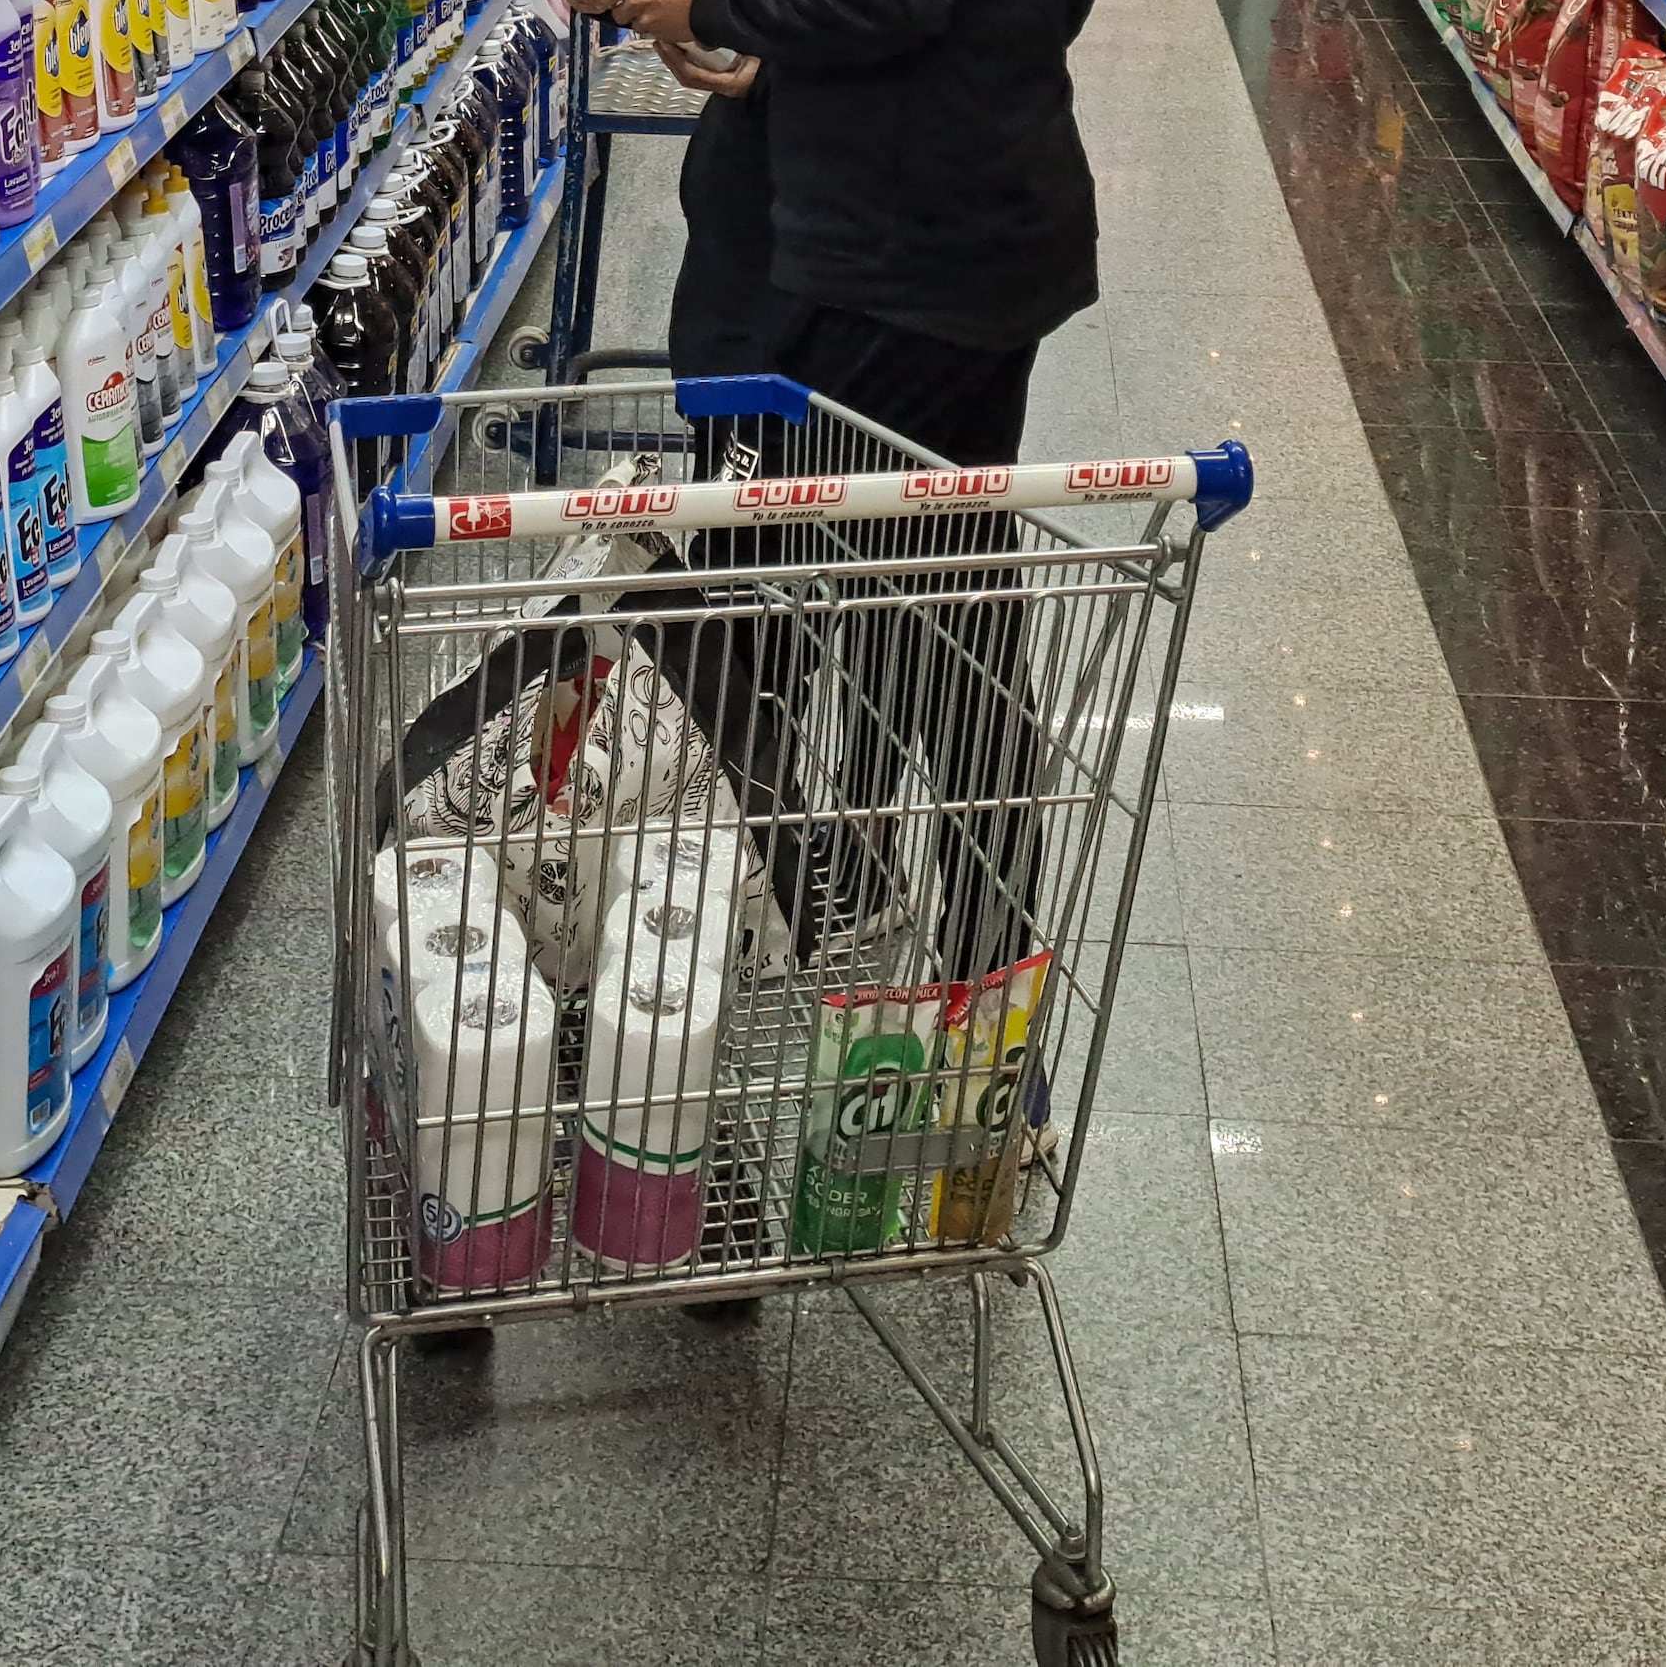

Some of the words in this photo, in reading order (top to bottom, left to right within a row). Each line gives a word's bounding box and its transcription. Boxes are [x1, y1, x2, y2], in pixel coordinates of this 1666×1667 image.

[901, 467, 1012, 501] COTO
[1065, 459, 1174, 492] COTO
[563, 487, 679, 520] COTO
[733, 476, 849, 511] COTO
